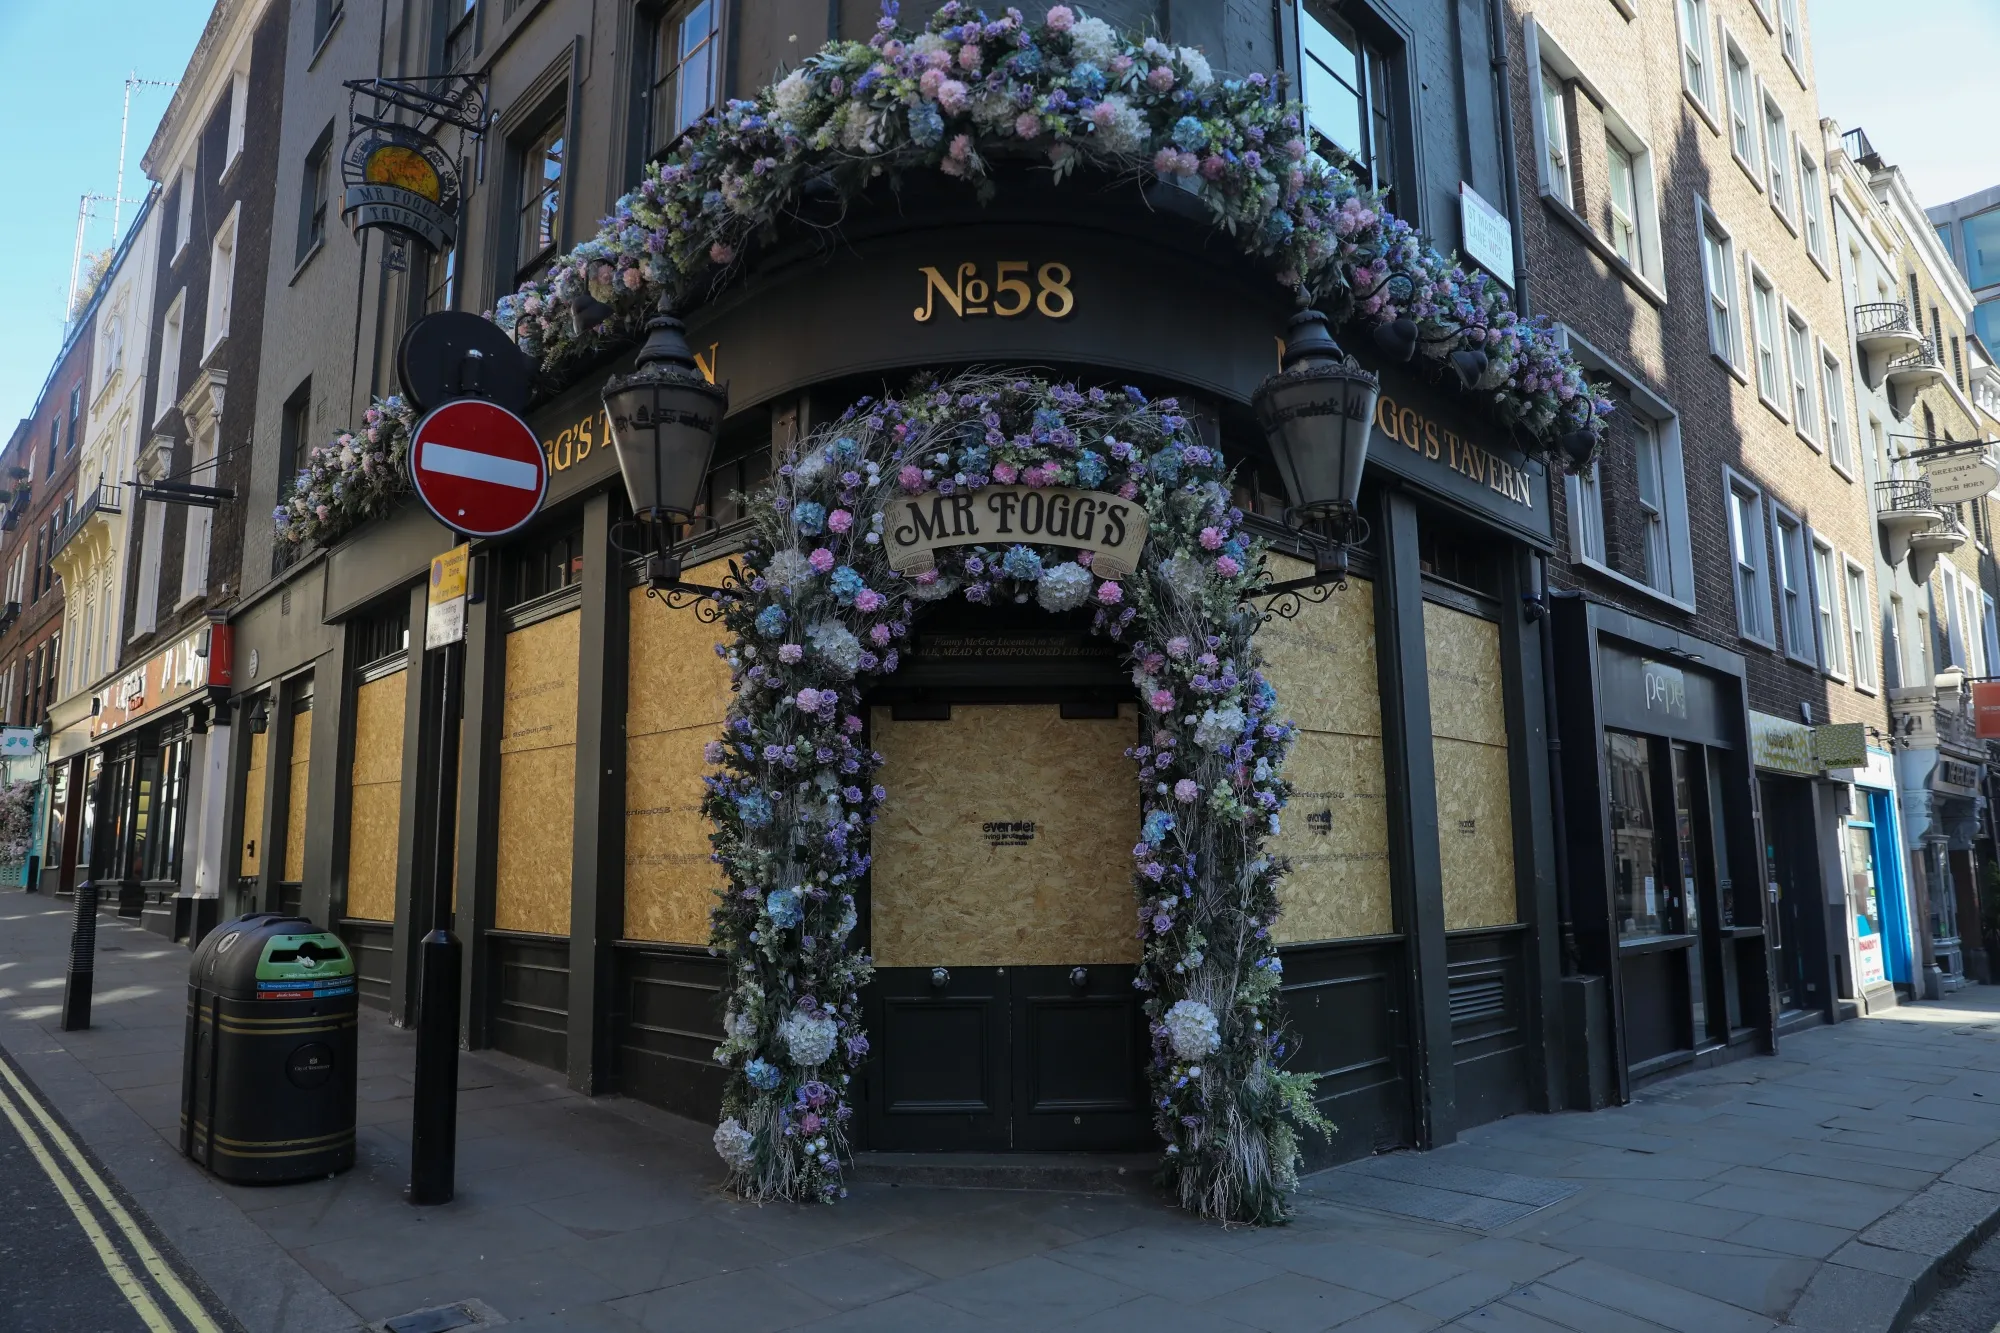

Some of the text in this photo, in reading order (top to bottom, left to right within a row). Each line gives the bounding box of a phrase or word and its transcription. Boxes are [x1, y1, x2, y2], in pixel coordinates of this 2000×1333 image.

[358, 187, 446, 224] MR FOGG'S
[370, 206, 434, 236] TAVERN
[1467, 204, 1476, 221] ST
[1478, 214, 1510, 251] MARTIN'S
[1469, 222, 1486, 249] LANE
[1444, 430, 1532, 508] TAVERN
[1963, 480, 1985, 489] HORN
[895, 490, 1130, 548] MR FOGG'S
[943, 647, 972, 656] MEAD
[974, 648, 983, 656] &
[986, 647, 1060, 656] COMPOUNDED
[963, 637, 995, 646] McGee
